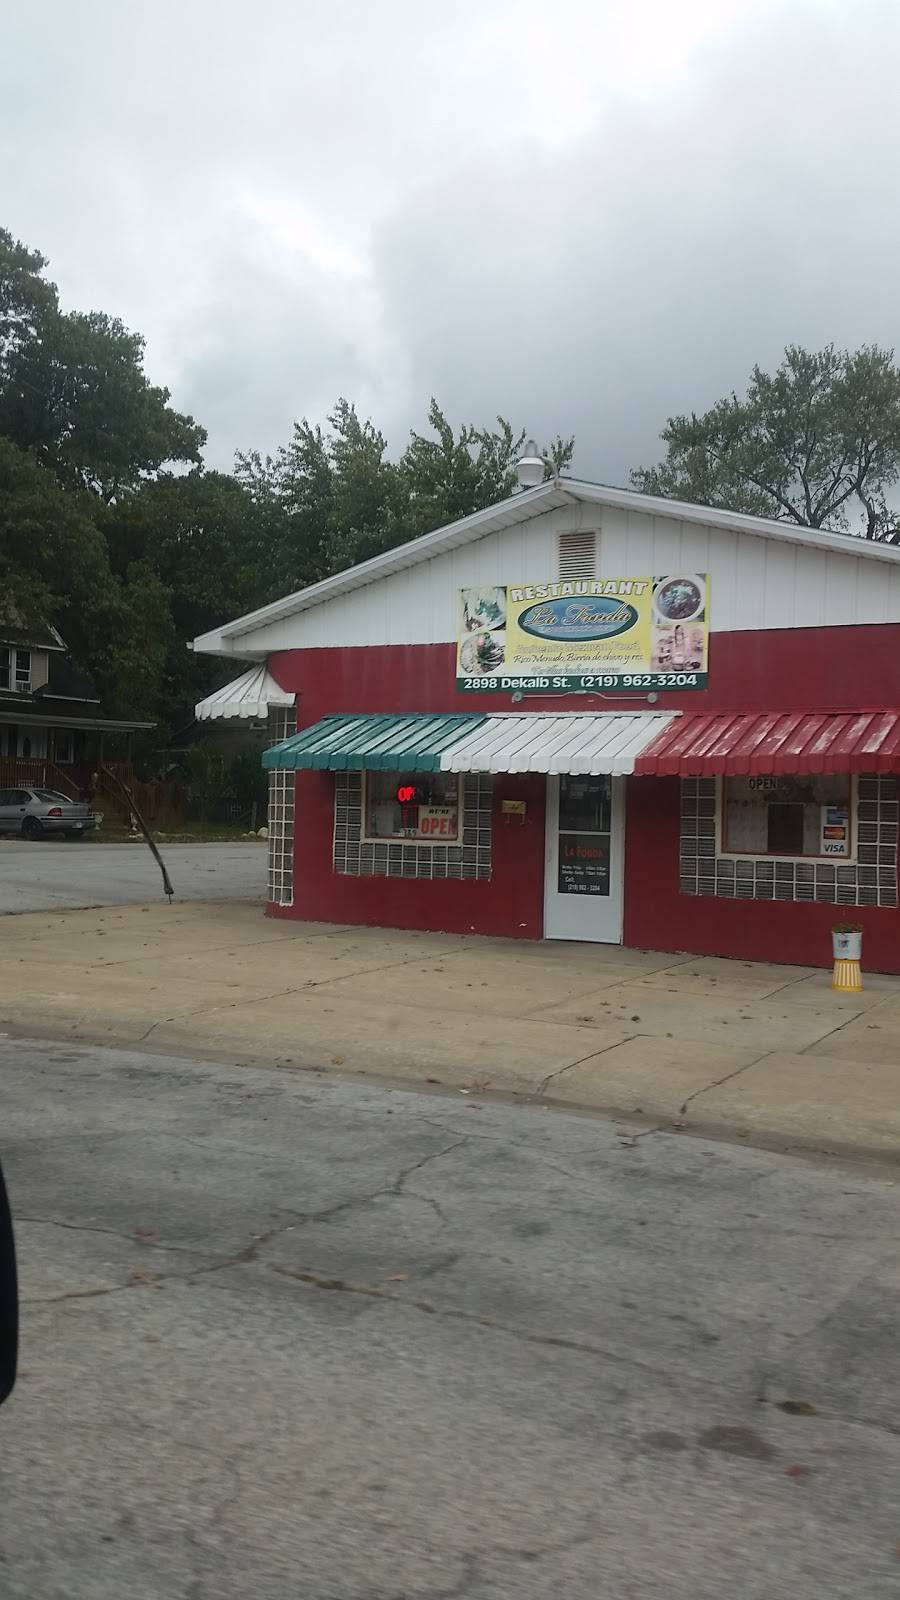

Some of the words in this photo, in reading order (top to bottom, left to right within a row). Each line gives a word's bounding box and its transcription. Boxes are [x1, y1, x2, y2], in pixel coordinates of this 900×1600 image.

[511, 580, 648, 602] RESTAURANT
[523, 605, 558, 626] La
[463, 677, 498, 689] 2898
[501, 676, 549, 688] Dekalb
[552, 676, 572, 688] St.
[580, 675, 618, 687] (219)
[623, 673, 698, 687] 962-3204
[749, 778, 777, 790] OPEN
[421, 817, 456, 834] OPEN
[824, 844, 845, 853] VISA
